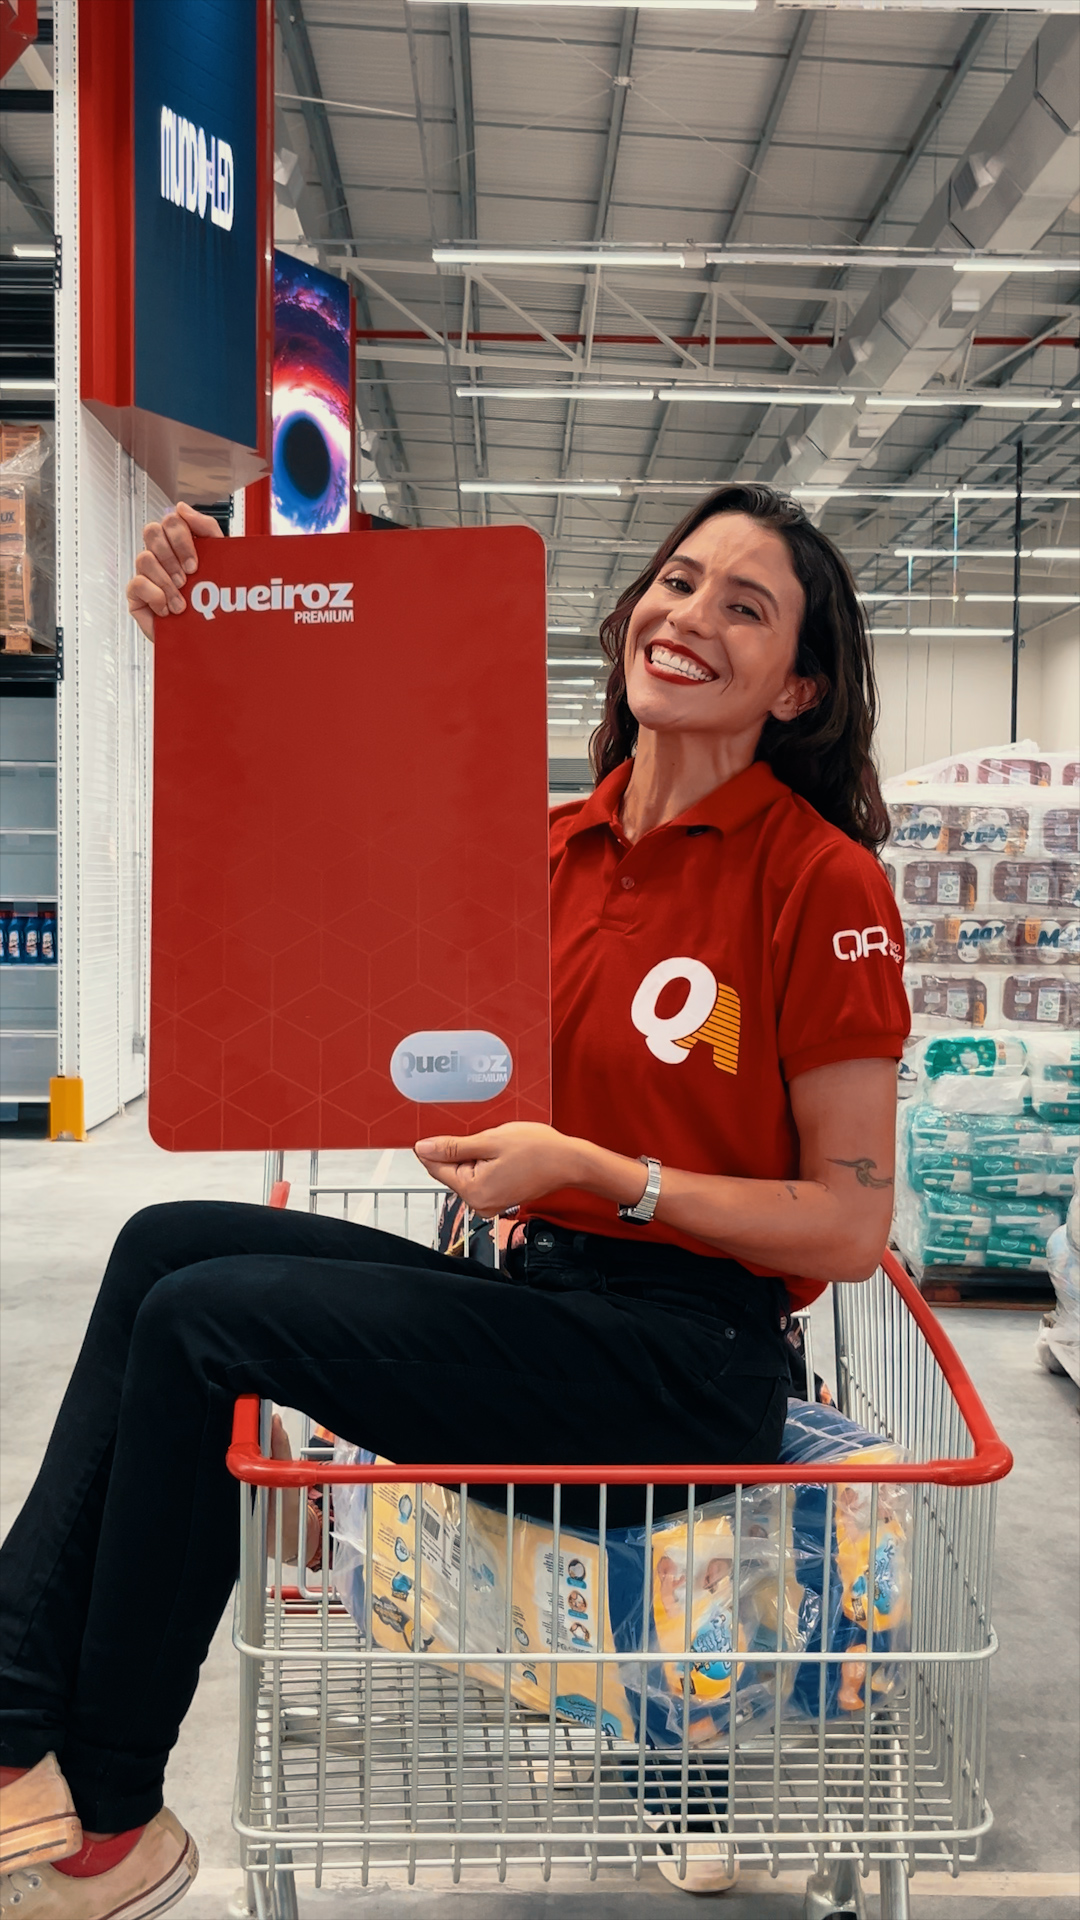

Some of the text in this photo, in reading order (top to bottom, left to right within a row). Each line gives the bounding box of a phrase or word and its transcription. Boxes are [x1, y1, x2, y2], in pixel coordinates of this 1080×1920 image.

[191, 577, 354, 620] Queiroz
[294, 609, 354, 624] PREMIUM
[467, 1073, 508, 1083] PREMIUM
